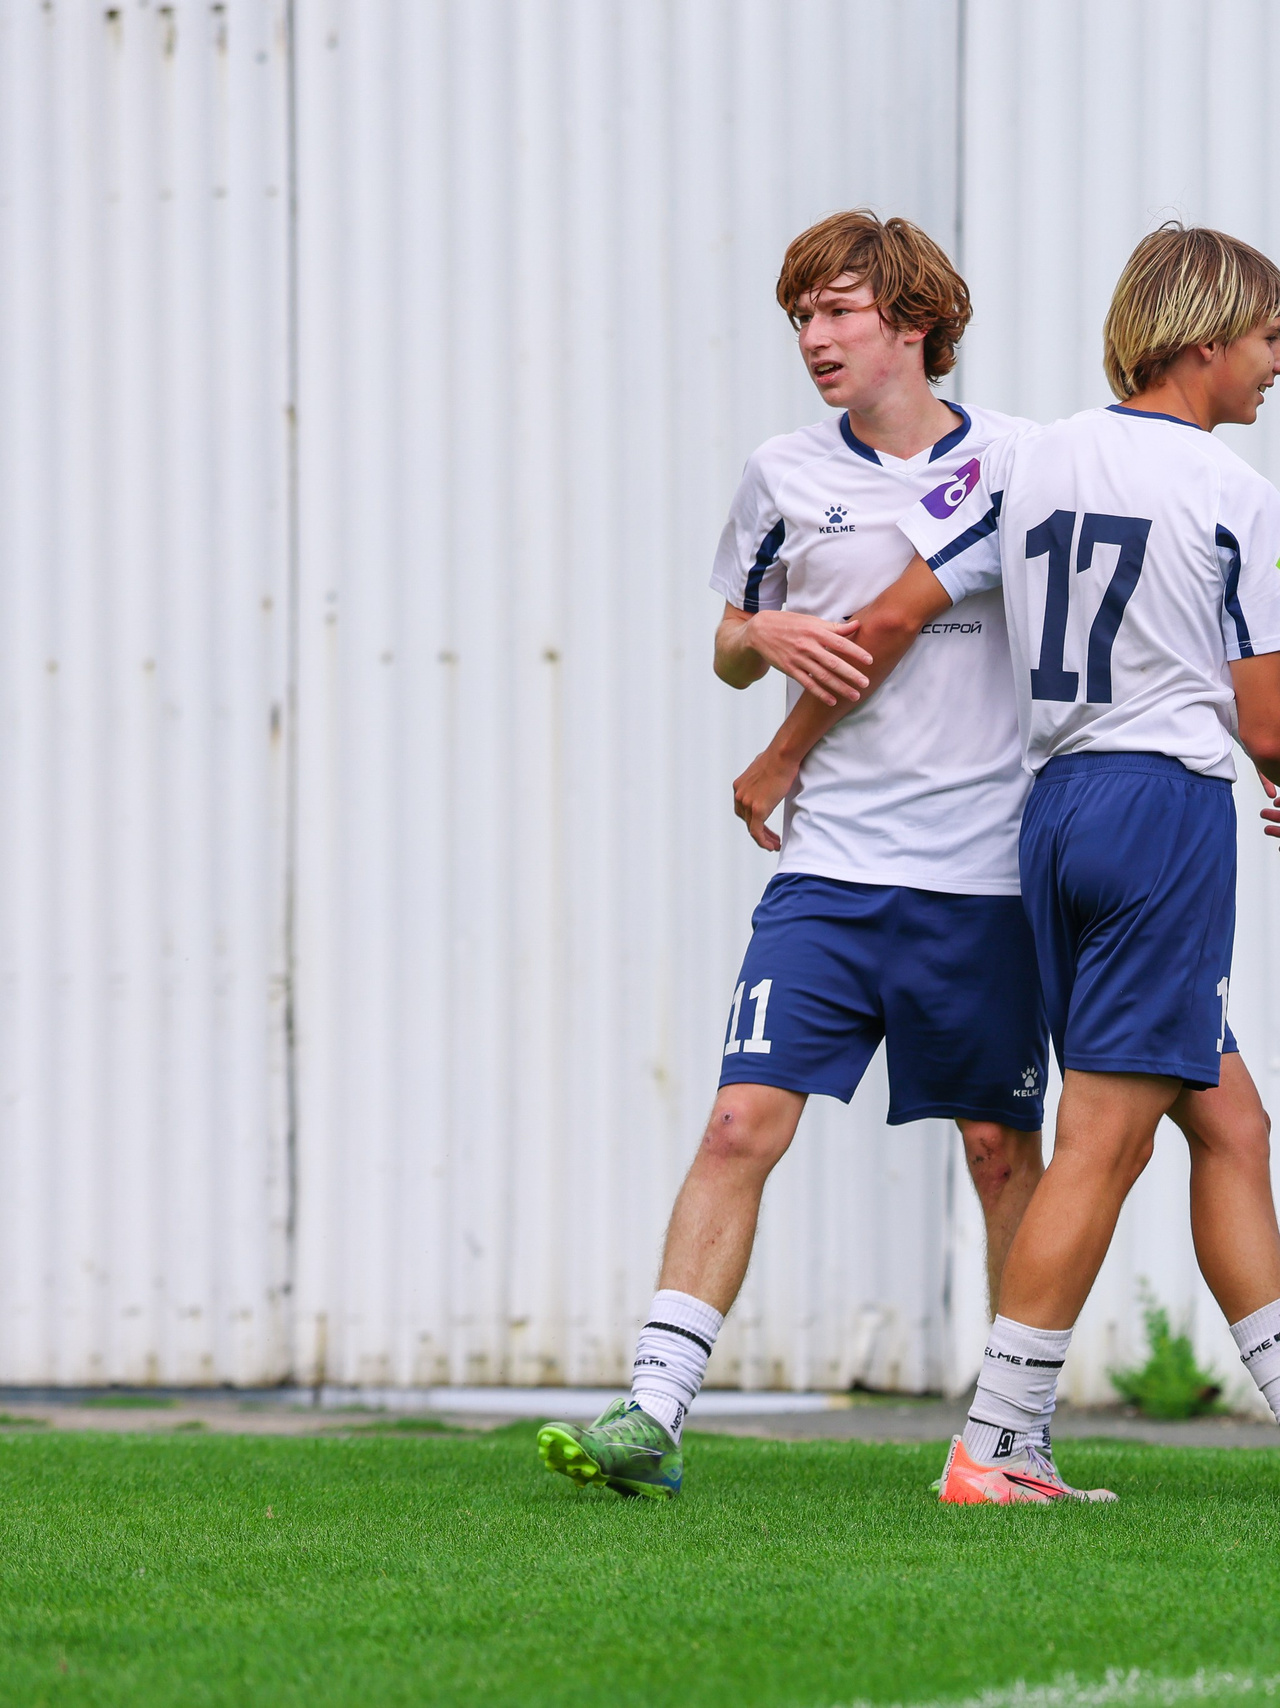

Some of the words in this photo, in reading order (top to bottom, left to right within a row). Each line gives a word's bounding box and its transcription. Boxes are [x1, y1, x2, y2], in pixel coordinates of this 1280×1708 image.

[819, 525, 856, 534] KELME
[1025, 509, 1153, 704] 17
[724, 978, 773, 1057] 11
[1013, 1088, 1040, 1098] KELME
